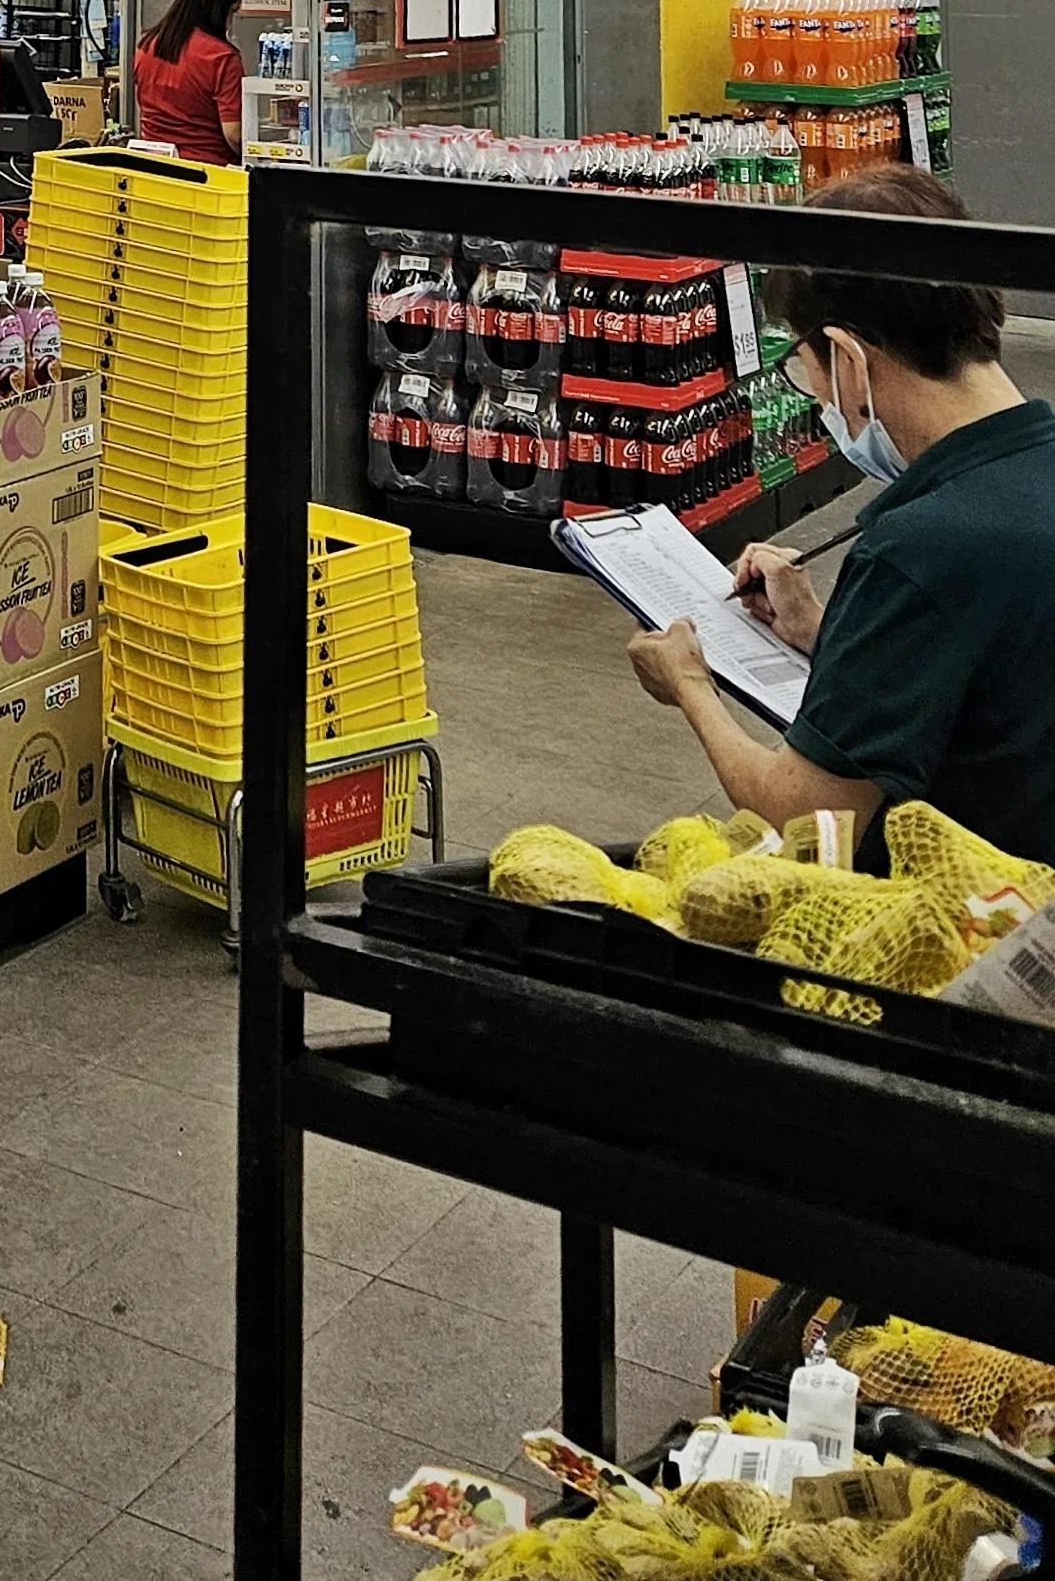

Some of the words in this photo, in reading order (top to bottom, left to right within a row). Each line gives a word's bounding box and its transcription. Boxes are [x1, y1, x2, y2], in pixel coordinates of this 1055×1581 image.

[10, 560, 30, 585] ICE
[38, 580, 51, 599] TEA
[28, 755, 47, 780] ICE
[13, 782, 41, 811] LEMON
[43, 771, 62, 796] TEA
